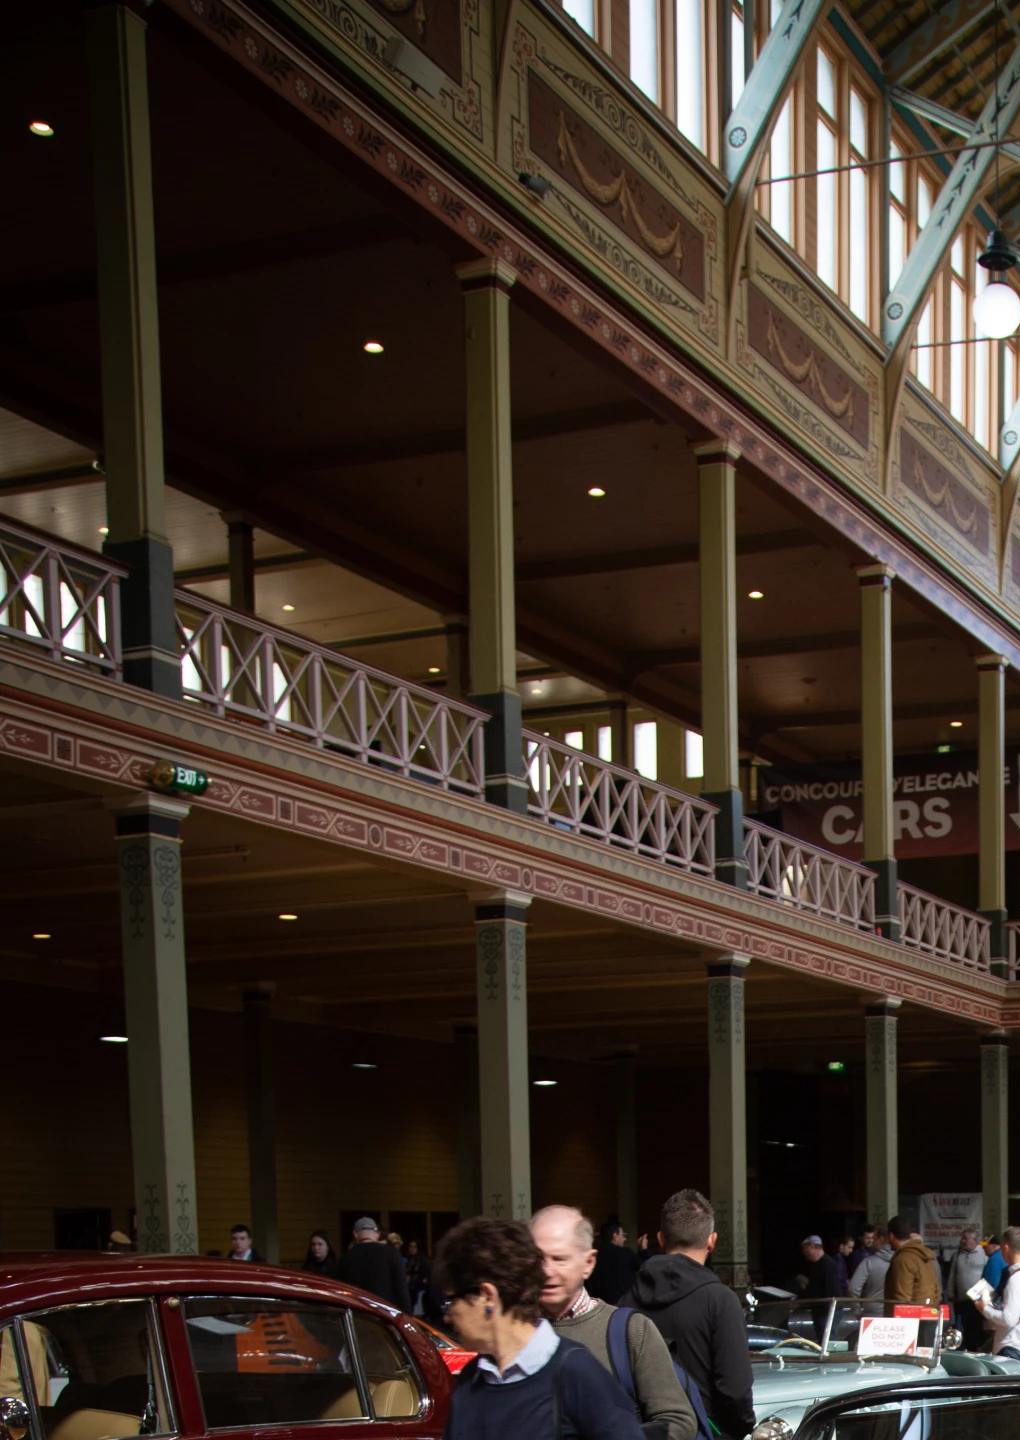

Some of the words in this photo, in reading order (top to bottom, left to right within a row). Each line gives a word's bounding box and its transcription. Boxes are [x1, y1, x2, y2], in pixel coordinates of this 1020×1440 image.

[176, 766, 197, 787] EXIT
[765, 781, 863, 804] CONCOUR
[893, 767, 1011, 794] 'ELEGANE
[821, 797, 953, 845] CRS
